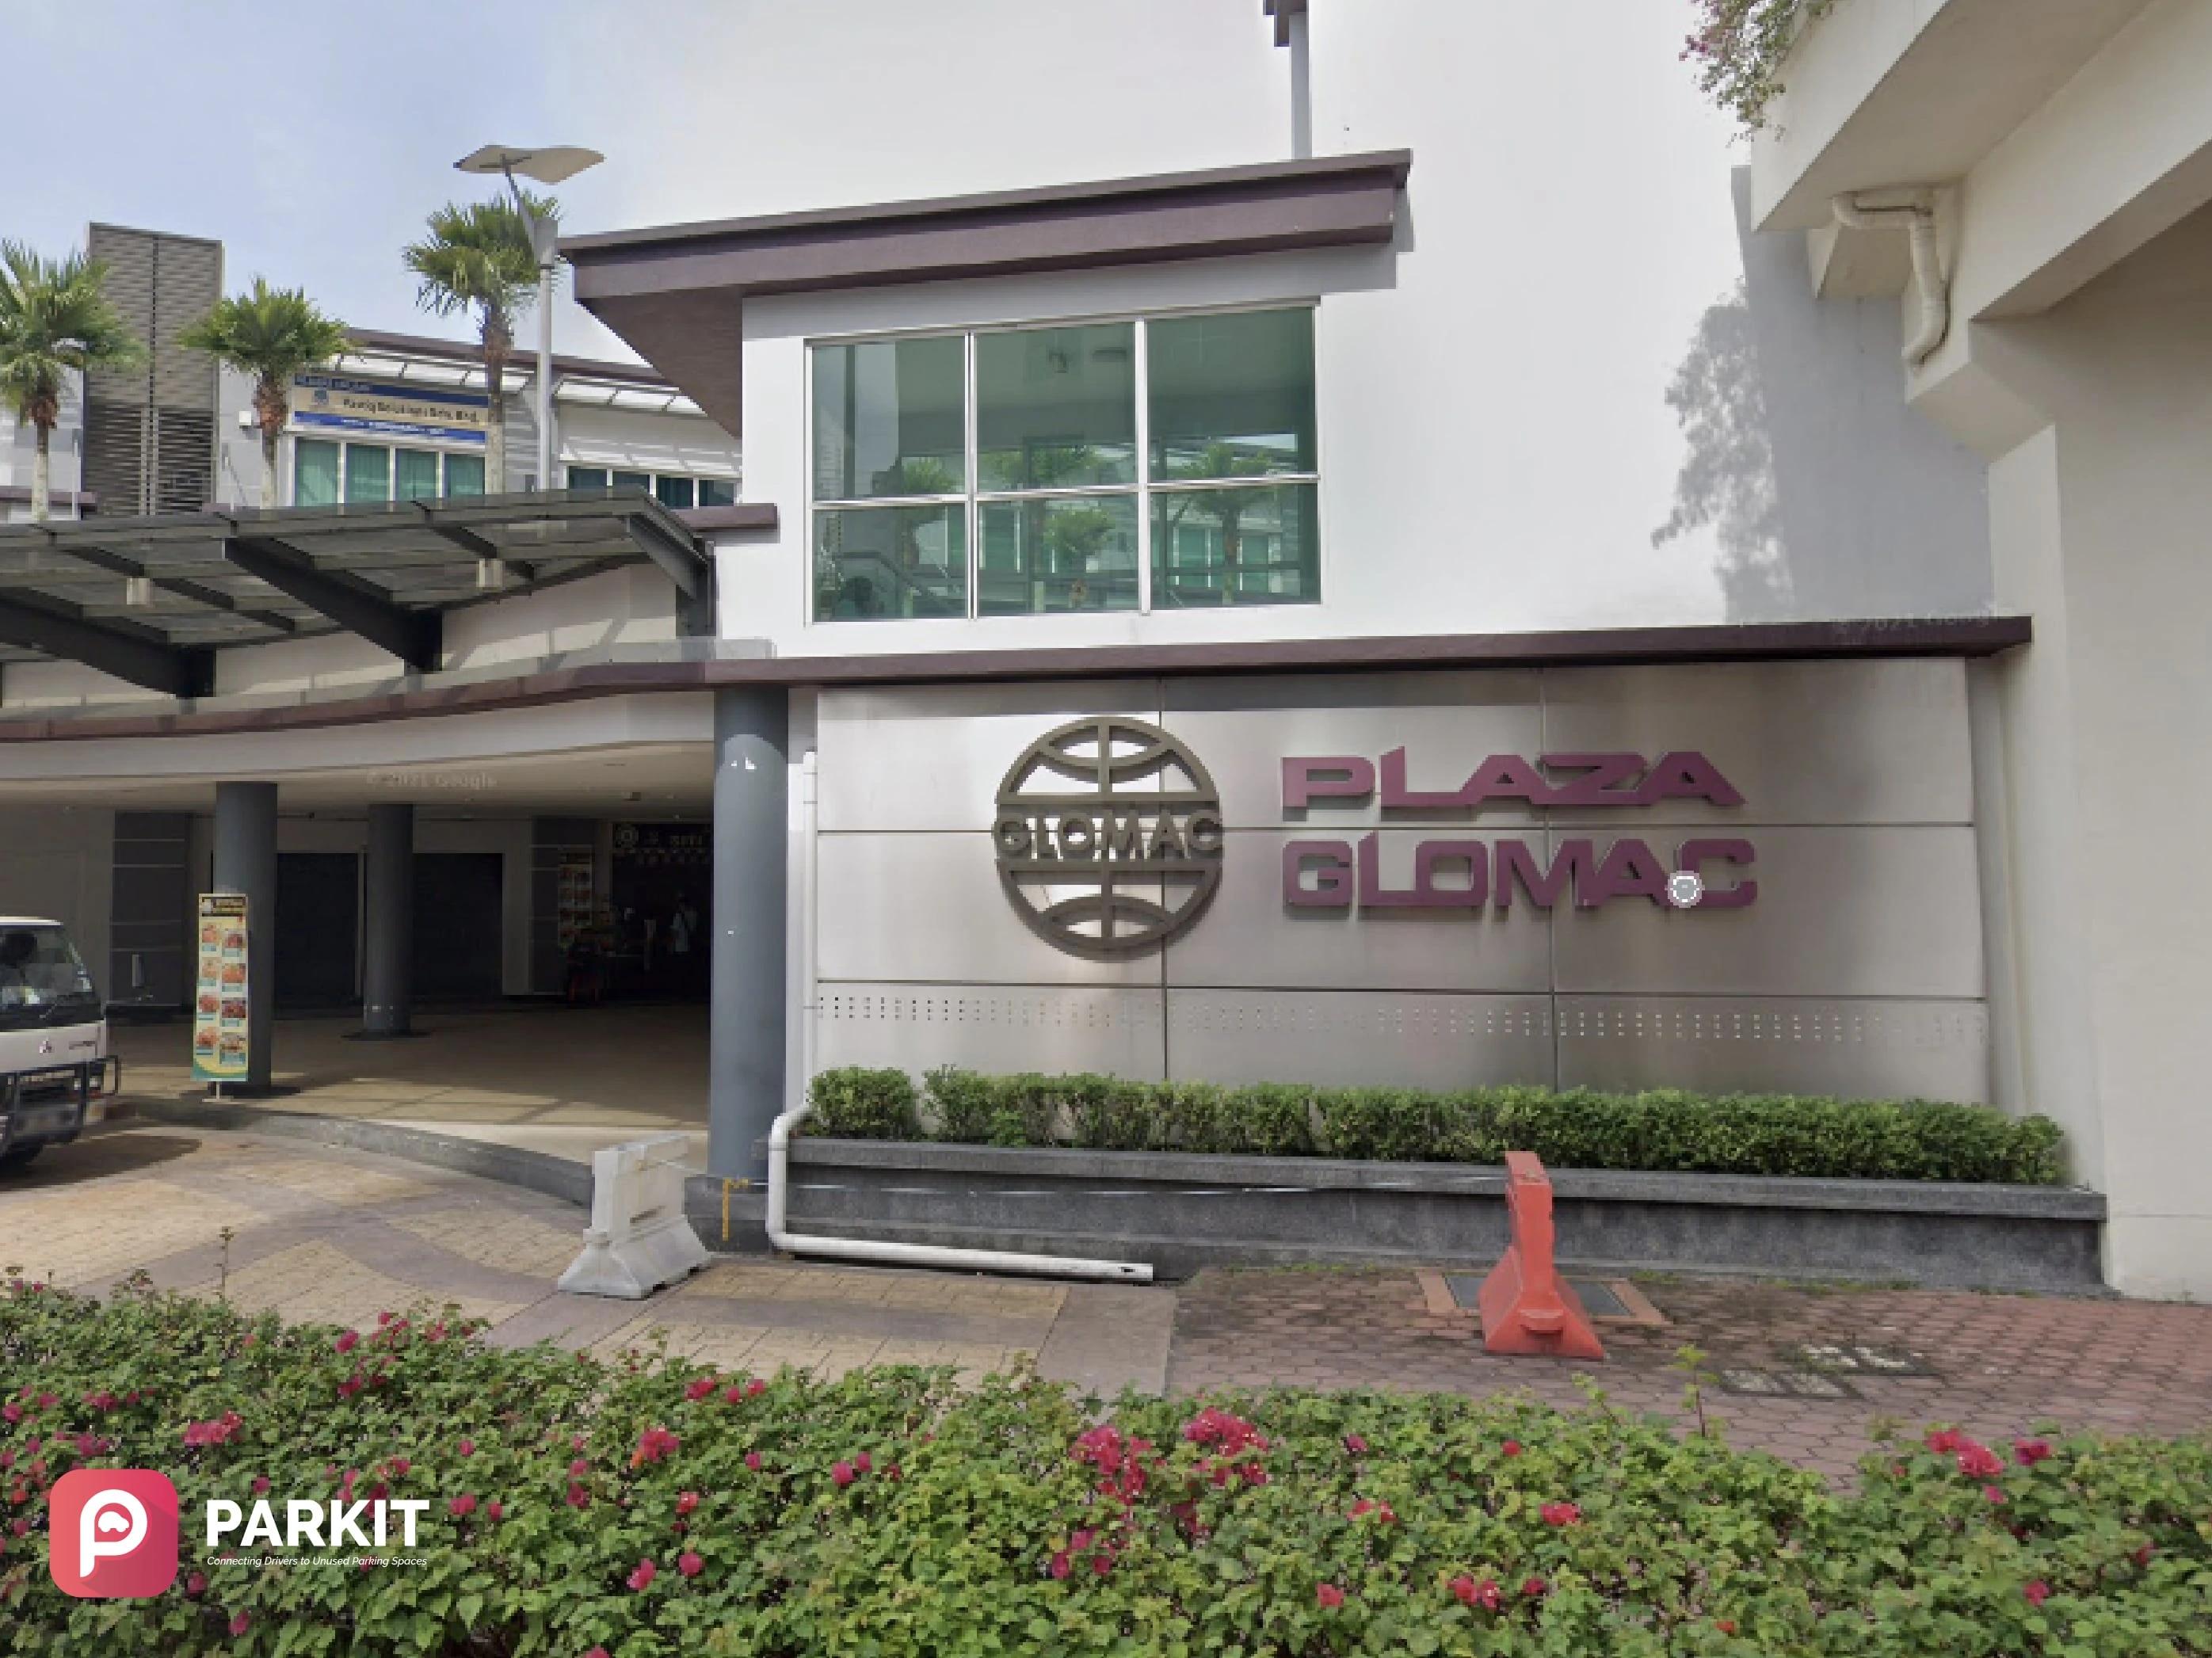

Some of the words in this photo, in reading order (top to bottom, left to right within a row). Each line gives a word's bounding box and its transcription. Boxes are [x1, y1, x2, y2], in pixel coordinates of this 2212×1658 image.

[1281, 745, 1748, 816] PLAZA
[993, 810, 1222, 860] GLOMAC
[1282, 830, 1758, 914] GLOMAC
